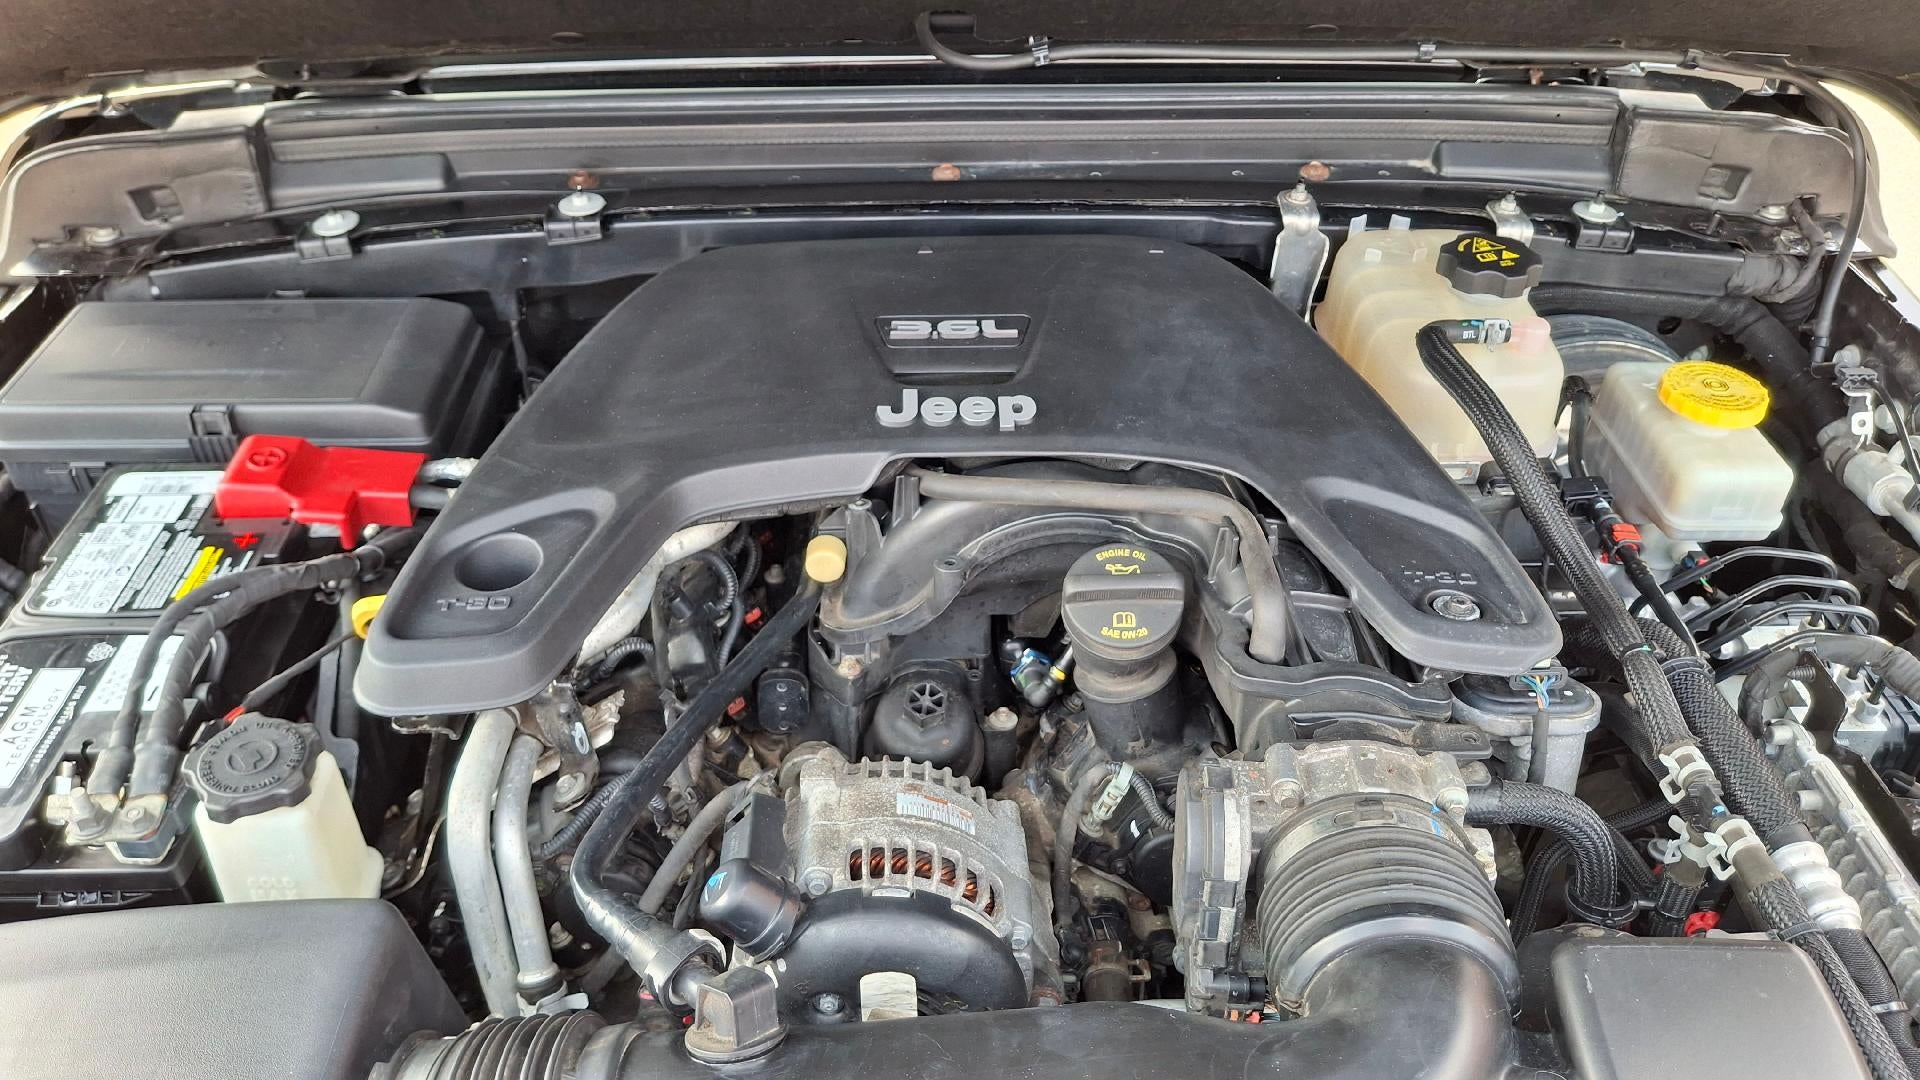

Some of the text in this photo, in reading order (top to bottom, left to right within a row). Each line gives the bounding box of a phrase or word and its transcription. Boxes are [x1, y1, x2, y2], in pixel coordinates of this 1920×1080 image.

[889, 319, 1018, 340] 3.6L
[876, 388, 1037, 431] Jeep
[1095, 548, 1147, 561] ENGINE OIL
[1100, 626, 1148, 639] SAE 0W-20
[4, 706, 40, 745] AGM
[6, 688, 65, 767] TECHNOLOGY
[247, 877, 297, 888] COLD
